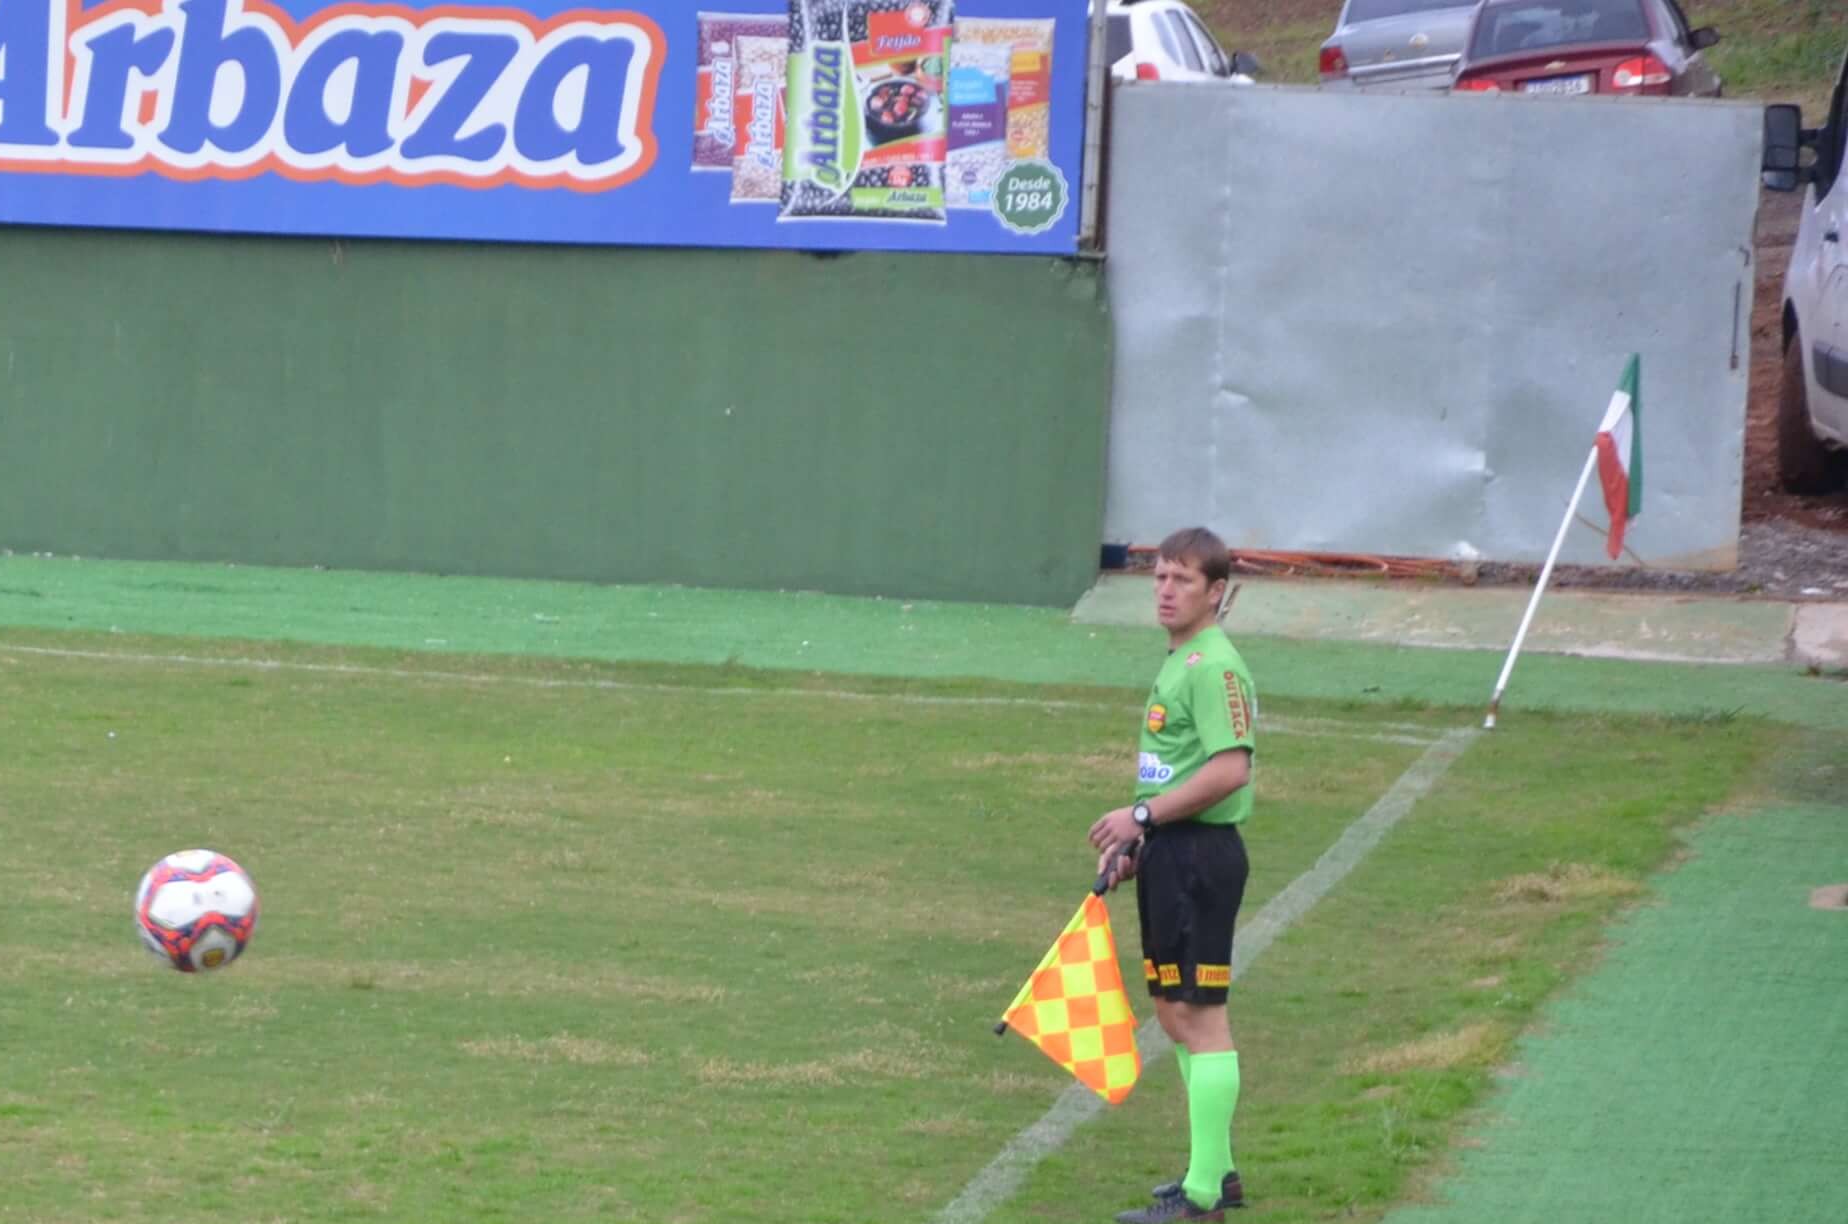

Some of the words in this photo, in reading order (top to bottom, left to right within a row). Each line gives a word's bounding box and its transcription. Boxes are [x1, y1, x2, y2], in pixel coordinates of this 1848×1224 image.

[801, 46, 843, 187] Arbaza
[1005, 191, 1053, 211] 1984
[1007, 176, 1051, 192] Desde
[1223, 671, 1246, 740] OUTBACK
